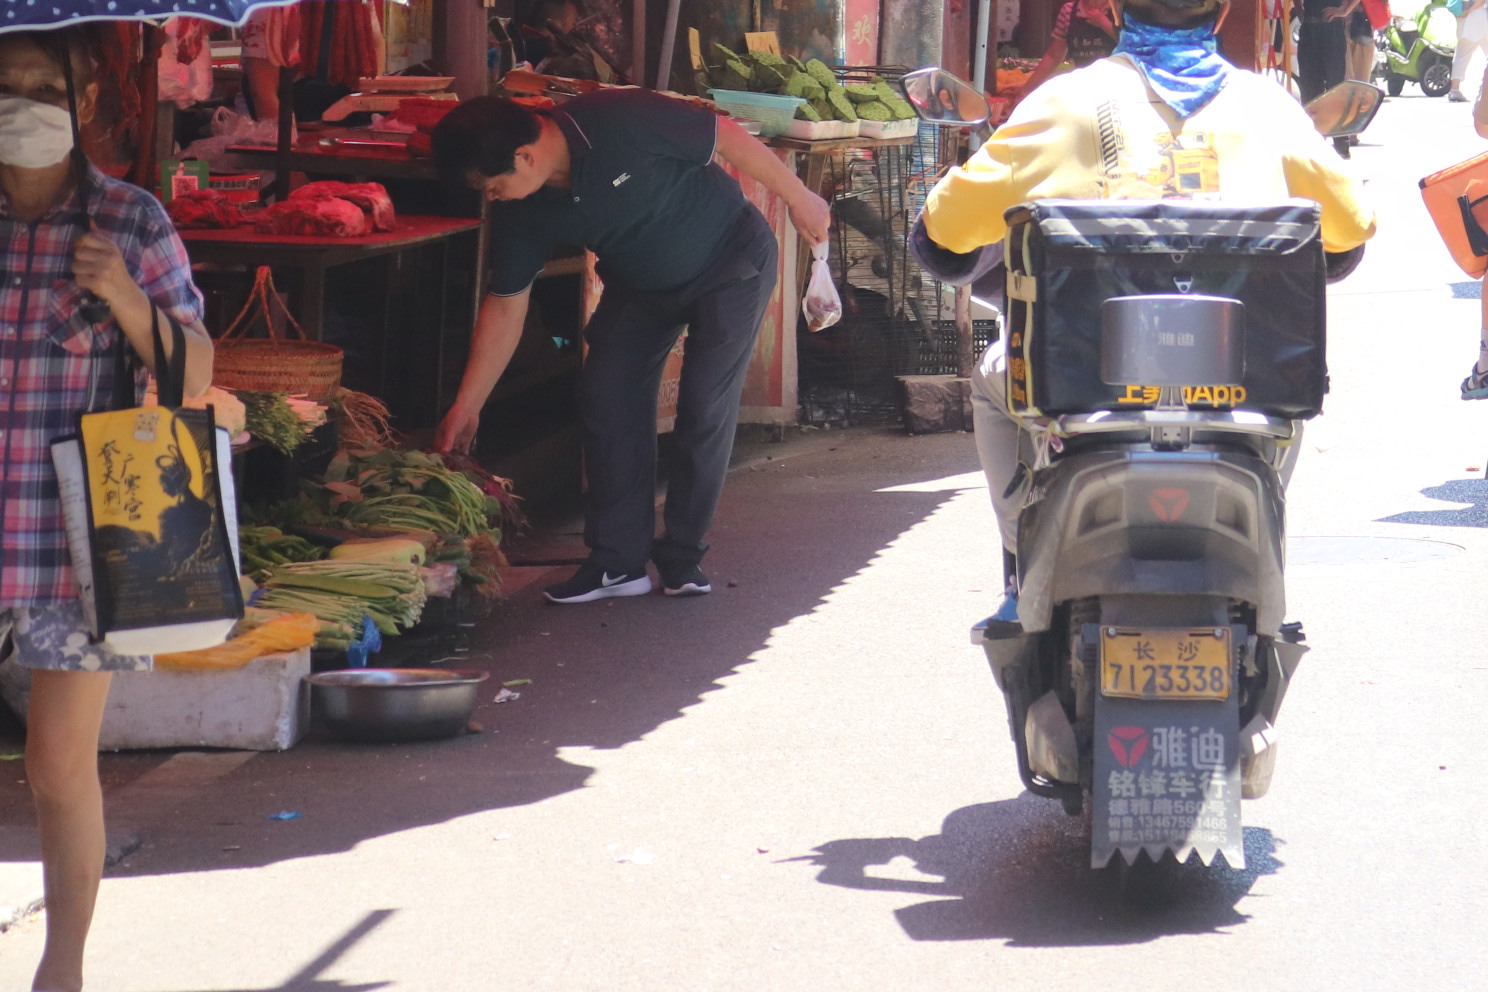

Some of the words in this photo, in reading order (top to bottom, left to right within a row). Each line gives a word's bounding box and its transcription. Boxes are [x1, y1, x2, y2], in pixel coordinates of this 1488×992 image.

[1158, 332, 1194, 346] 雅迪
[1132, 640, 1200, 662] 长沙
[1109, 662, 1225, 693] 7123338
[1152, 726, 1227, 771] 雅迪
